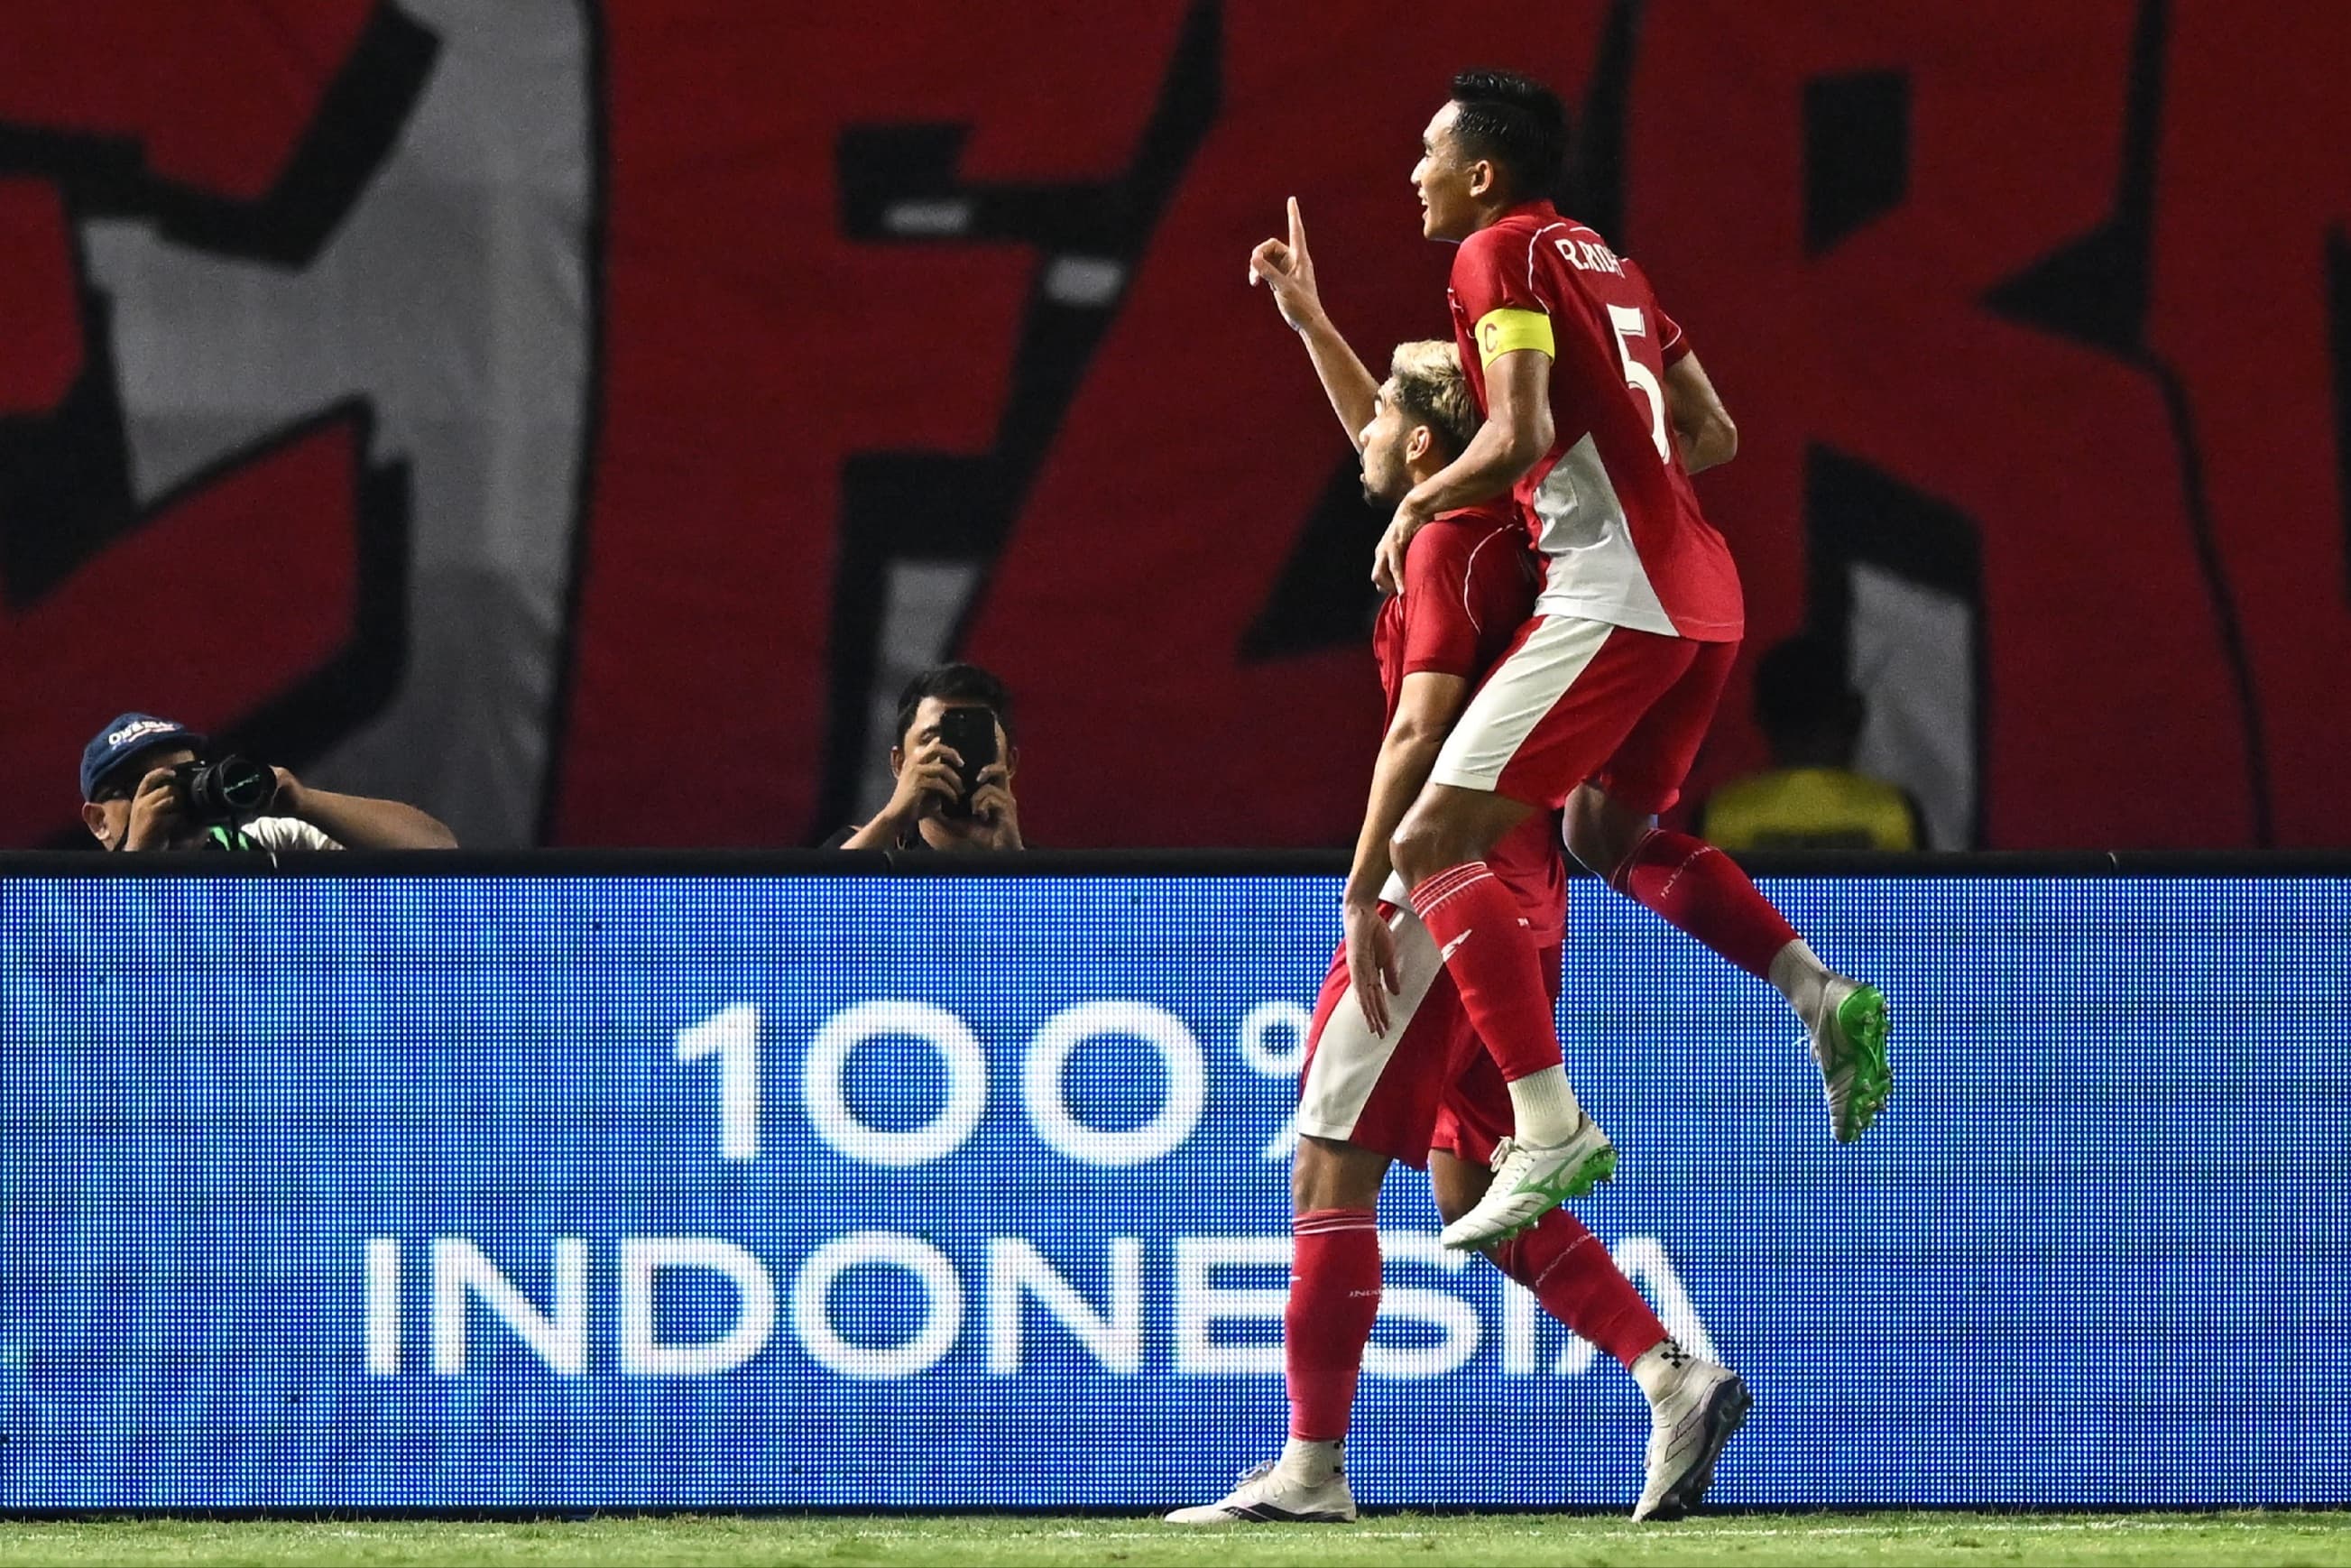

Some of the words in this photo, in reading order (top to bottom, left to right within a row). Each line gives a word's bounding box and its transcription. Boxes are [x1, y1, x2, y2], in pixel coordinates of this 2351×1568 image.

[1484, 323, 1498, 353] C
[1606, 303, 1669, 465] 5
[364, 1230, 1719, 1380] INDONESIA
